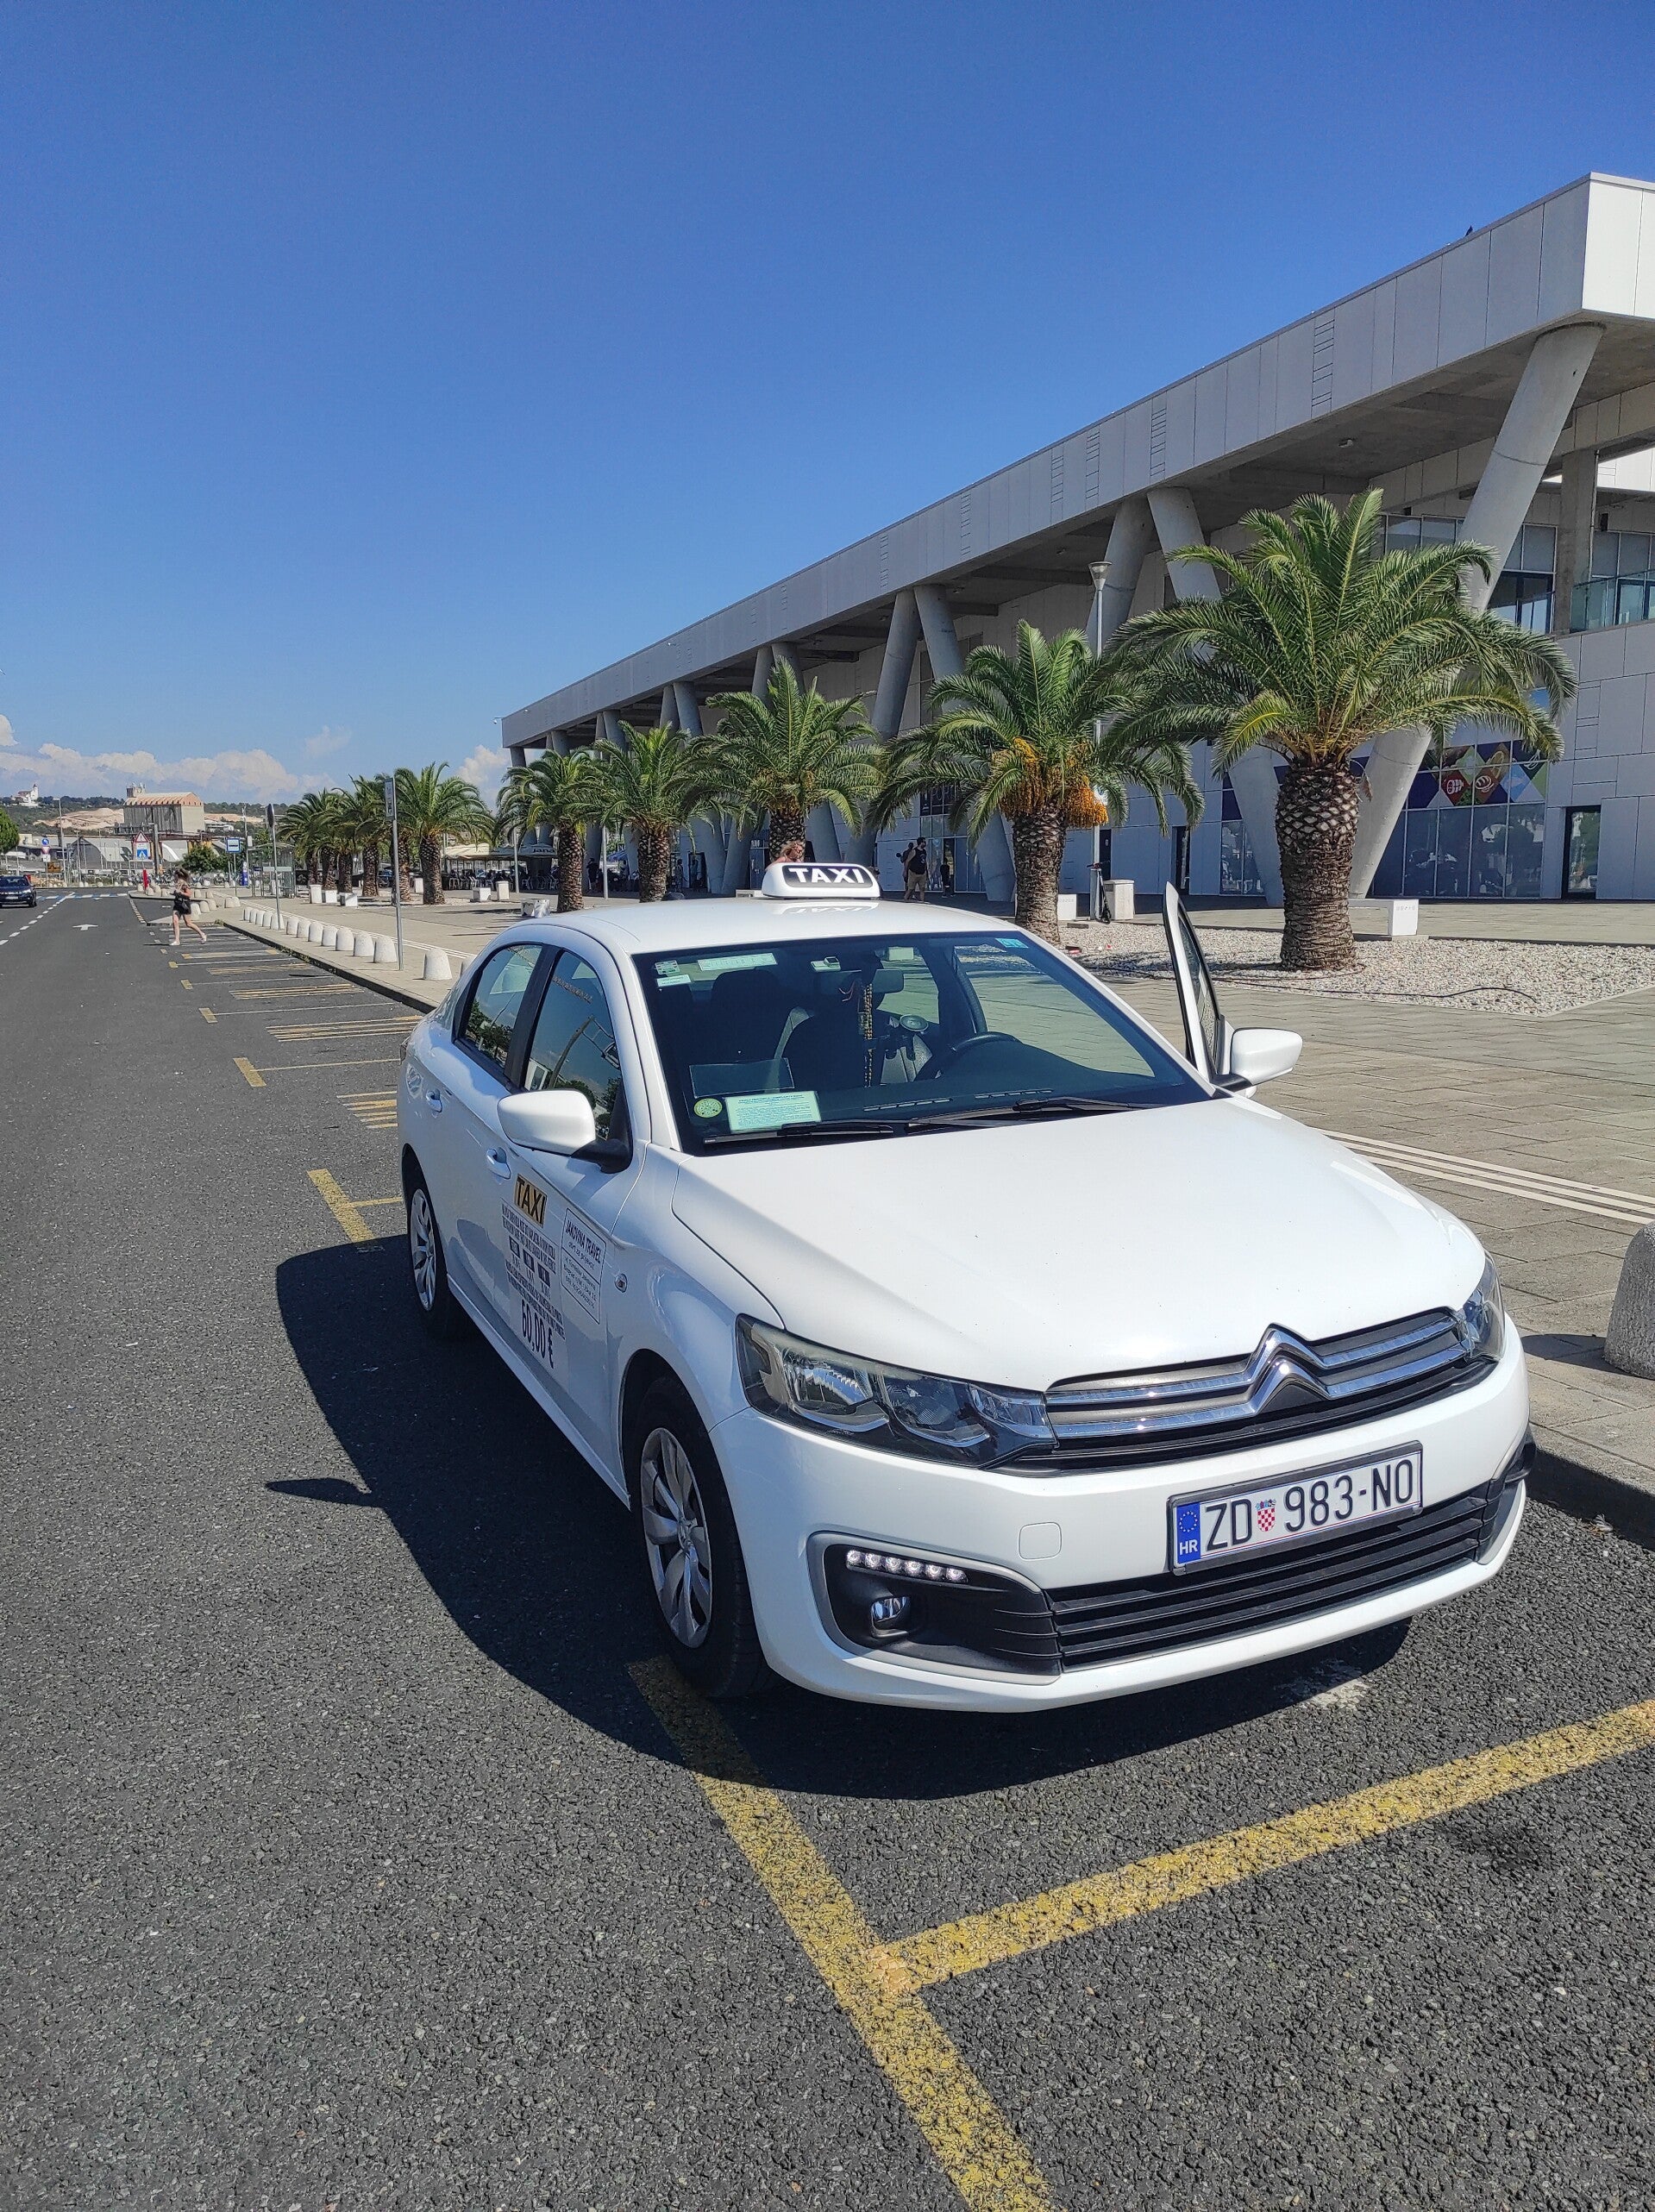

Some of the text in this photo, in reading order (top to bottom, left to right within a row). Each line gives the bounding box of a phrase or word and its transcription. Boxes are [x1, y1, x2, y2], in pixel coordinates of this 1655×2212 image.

[788, 868, 865, 884] TAXI
[517, 1175, 547, 1225] TAXI
[585, 1237, 602, 1265] TRAVEL
[521, 1298, 546, 1359] 60,00
[547, 1325, 555, 1369] €
[1206, 1458, 1414, 1551] ZD 983-NO
[1179, 1538, 1198, 1556] HR
